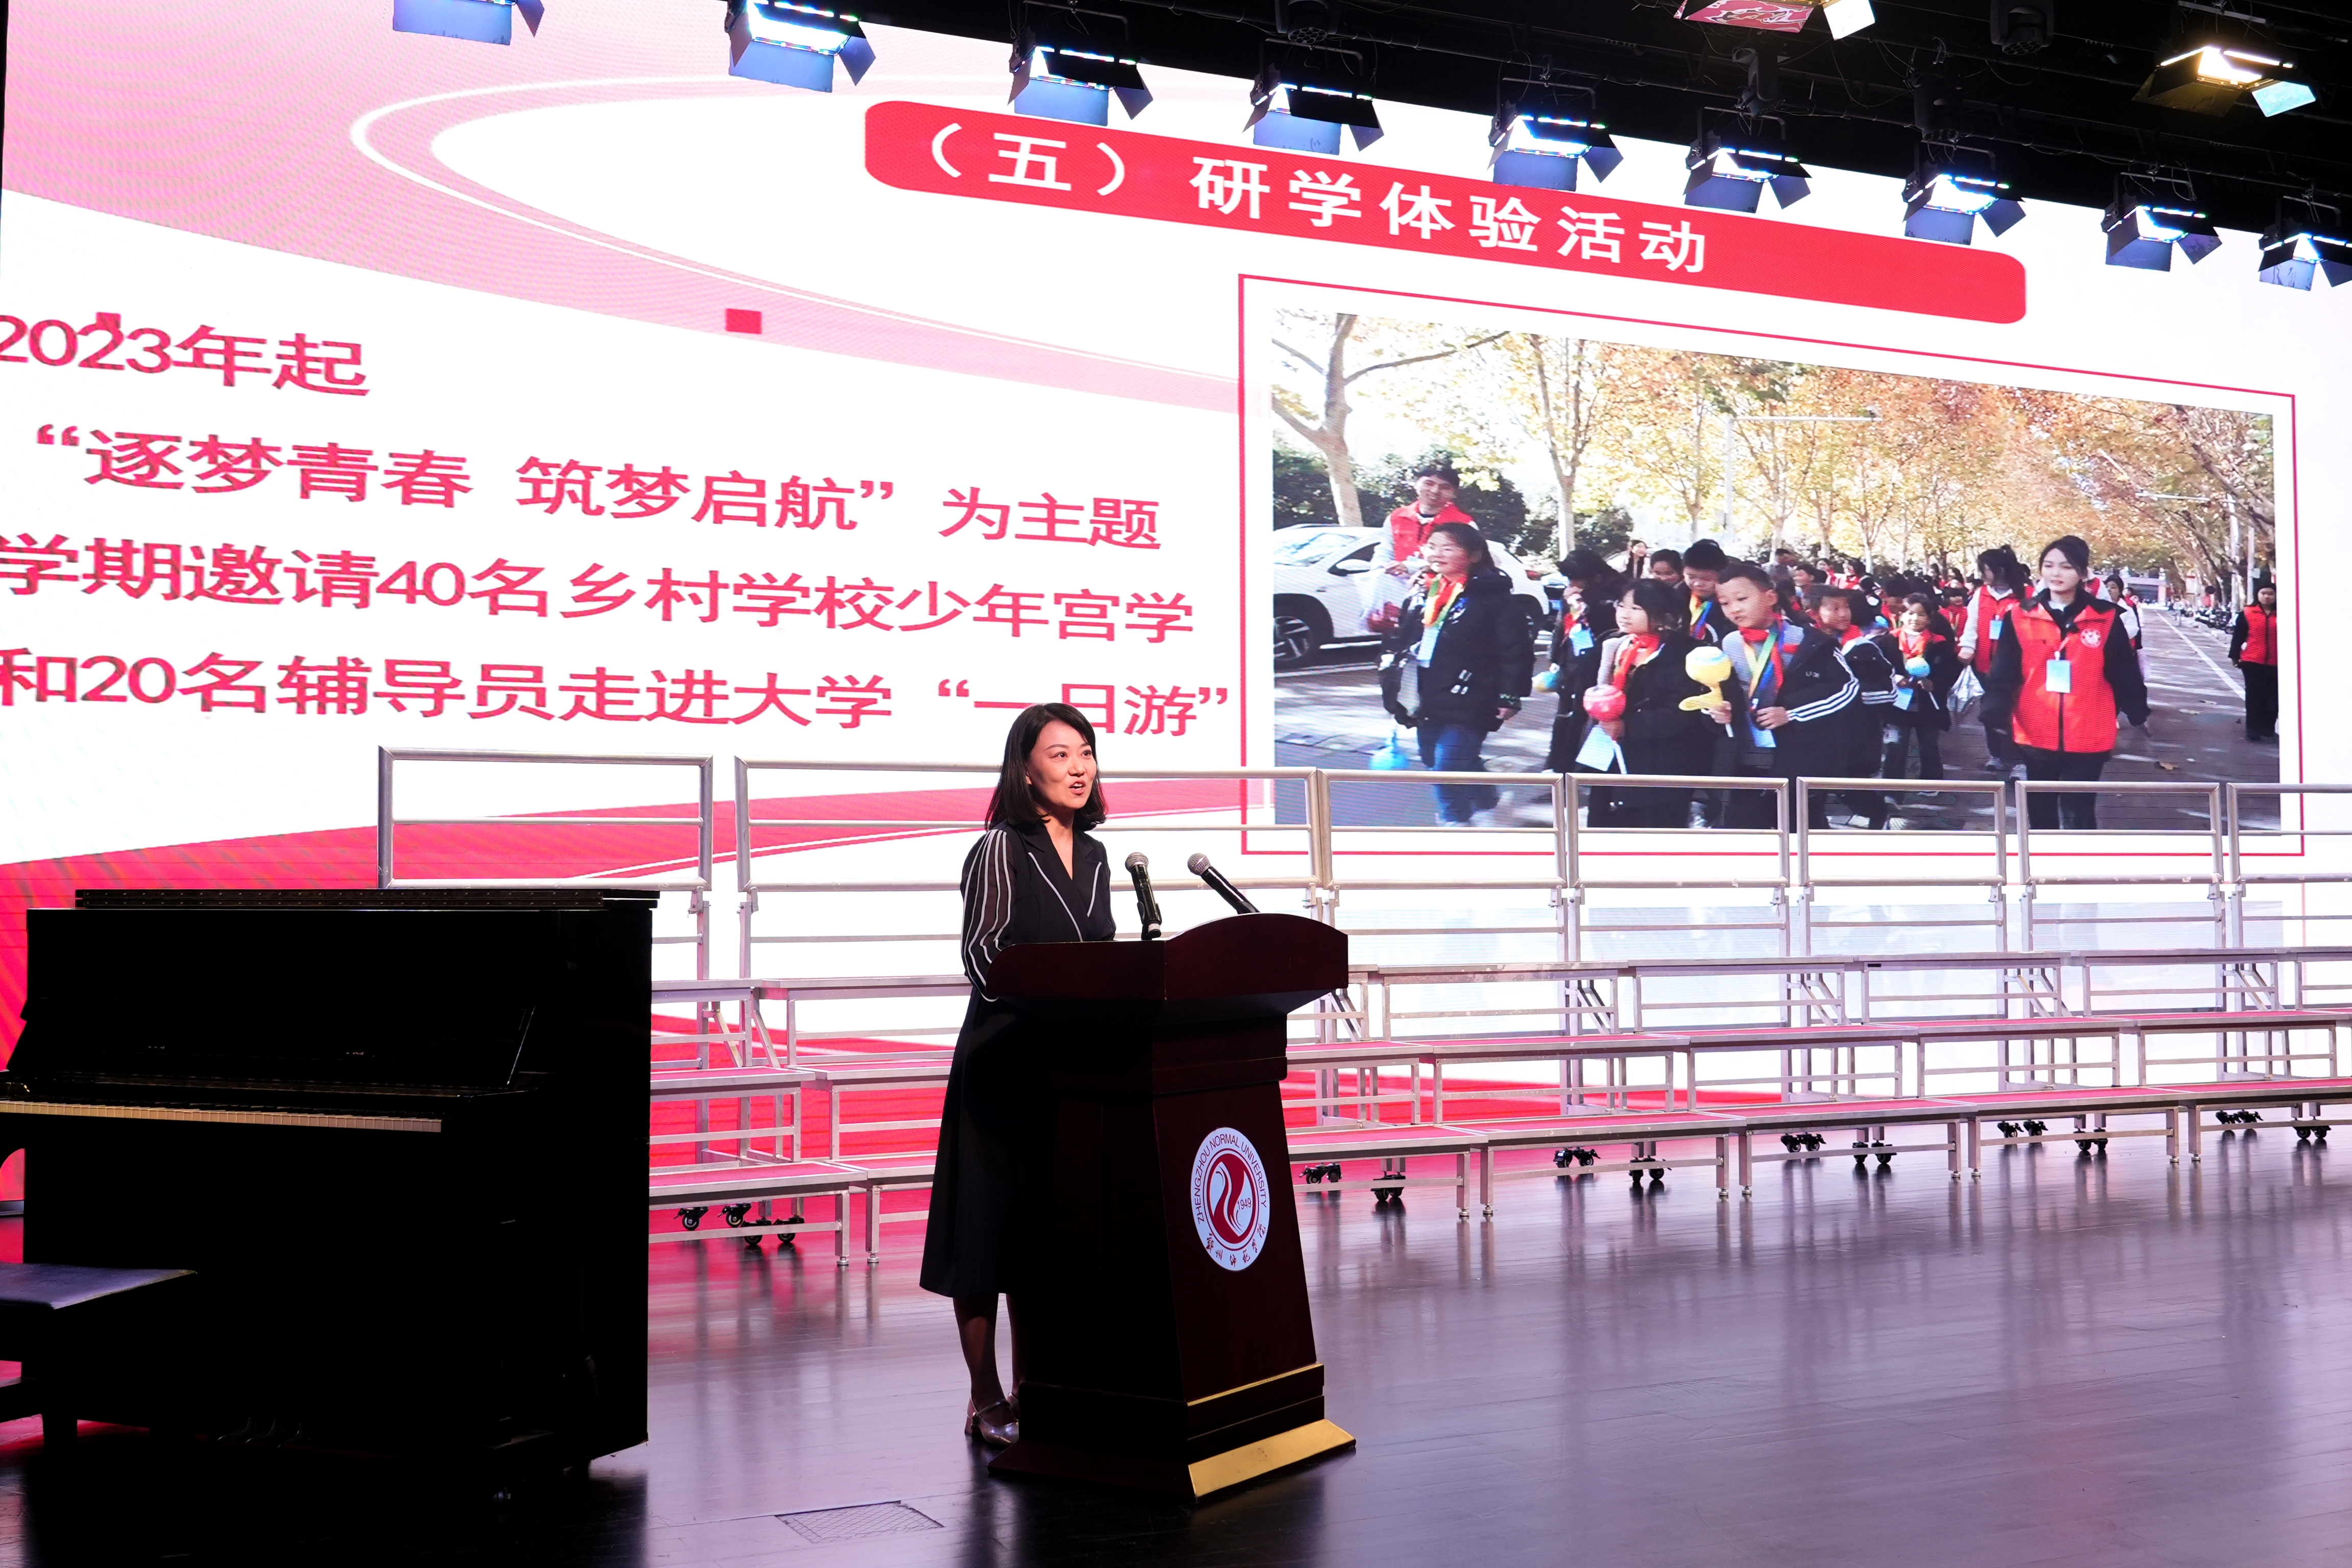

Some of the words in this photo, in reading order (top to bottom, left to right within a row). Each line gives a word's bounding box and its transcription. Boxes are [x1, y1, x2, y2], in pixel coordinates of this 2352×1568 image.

[0, 313, 370, 396] 2023年起
[0, 532, 1193, 643] 学期邀请40名乡村学校少年宫学
[1194, 1145, 1211, 1225] ZHENGZHOU
[1209, 1133, 1240, 1150] NORMAL
[1241, 1141, 1267, 1208] UNIVERSITY
[1237, 1197, 1252, 1210] 1949
